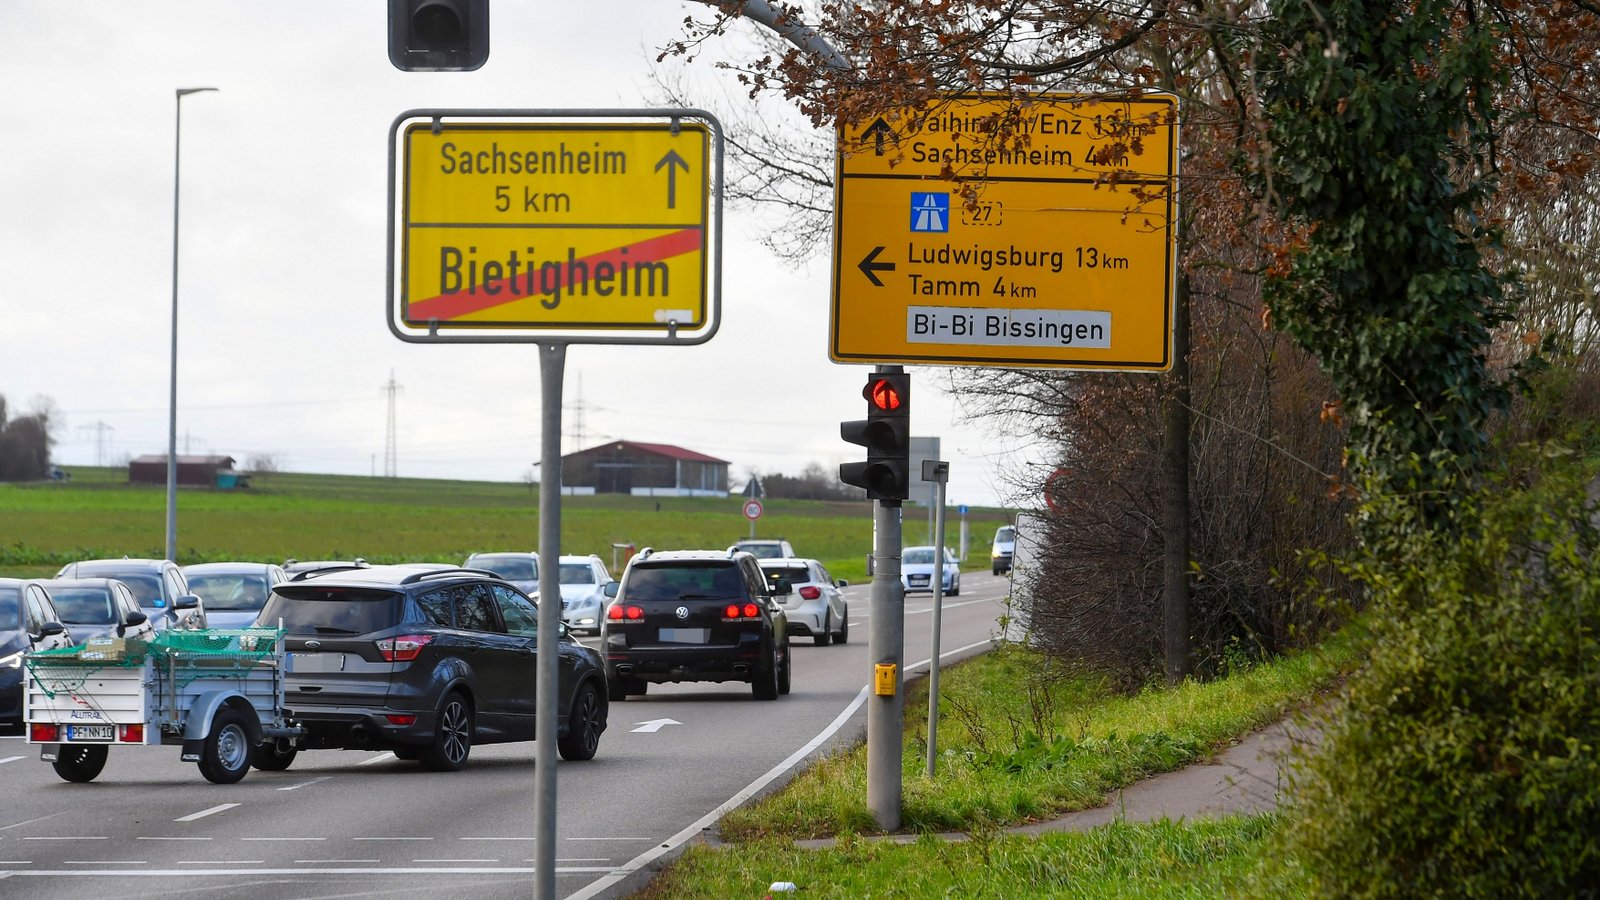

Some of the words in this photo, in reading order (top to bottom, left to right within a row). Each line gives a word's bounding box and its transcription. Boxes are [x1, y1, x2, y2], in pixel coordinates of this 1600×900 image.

[913, 111, 1081, 138] Vaihinn/Enz
[1094, 114, 1117, 136] 13
[440, 142, 626, 175] Sachsenheim
[912, 142, 1072, 166] Sachsenheim
[1085, 145, 1099, 166] 4
[1102, 150, 1129, 167] m
[495, 186, 510, 212] 5
[524, 186, 571, 212] km
[973, 206, 992, 221] 27
[908, 242, 1063, 272] Ludwigsburg
[1076, 247, 1098, 268] 13
[1102, 251, 1129, 269] km
[440, 246, 669, 310] Bietigheim
[908, 275, 980, 297] Tamm
[992, 277, 1006, 297] 4
[1010, 281, 1037, 298] km
[914, 314, 974, 336] Bi-Bi
[986, 316, 1103, 344] Bissingen
